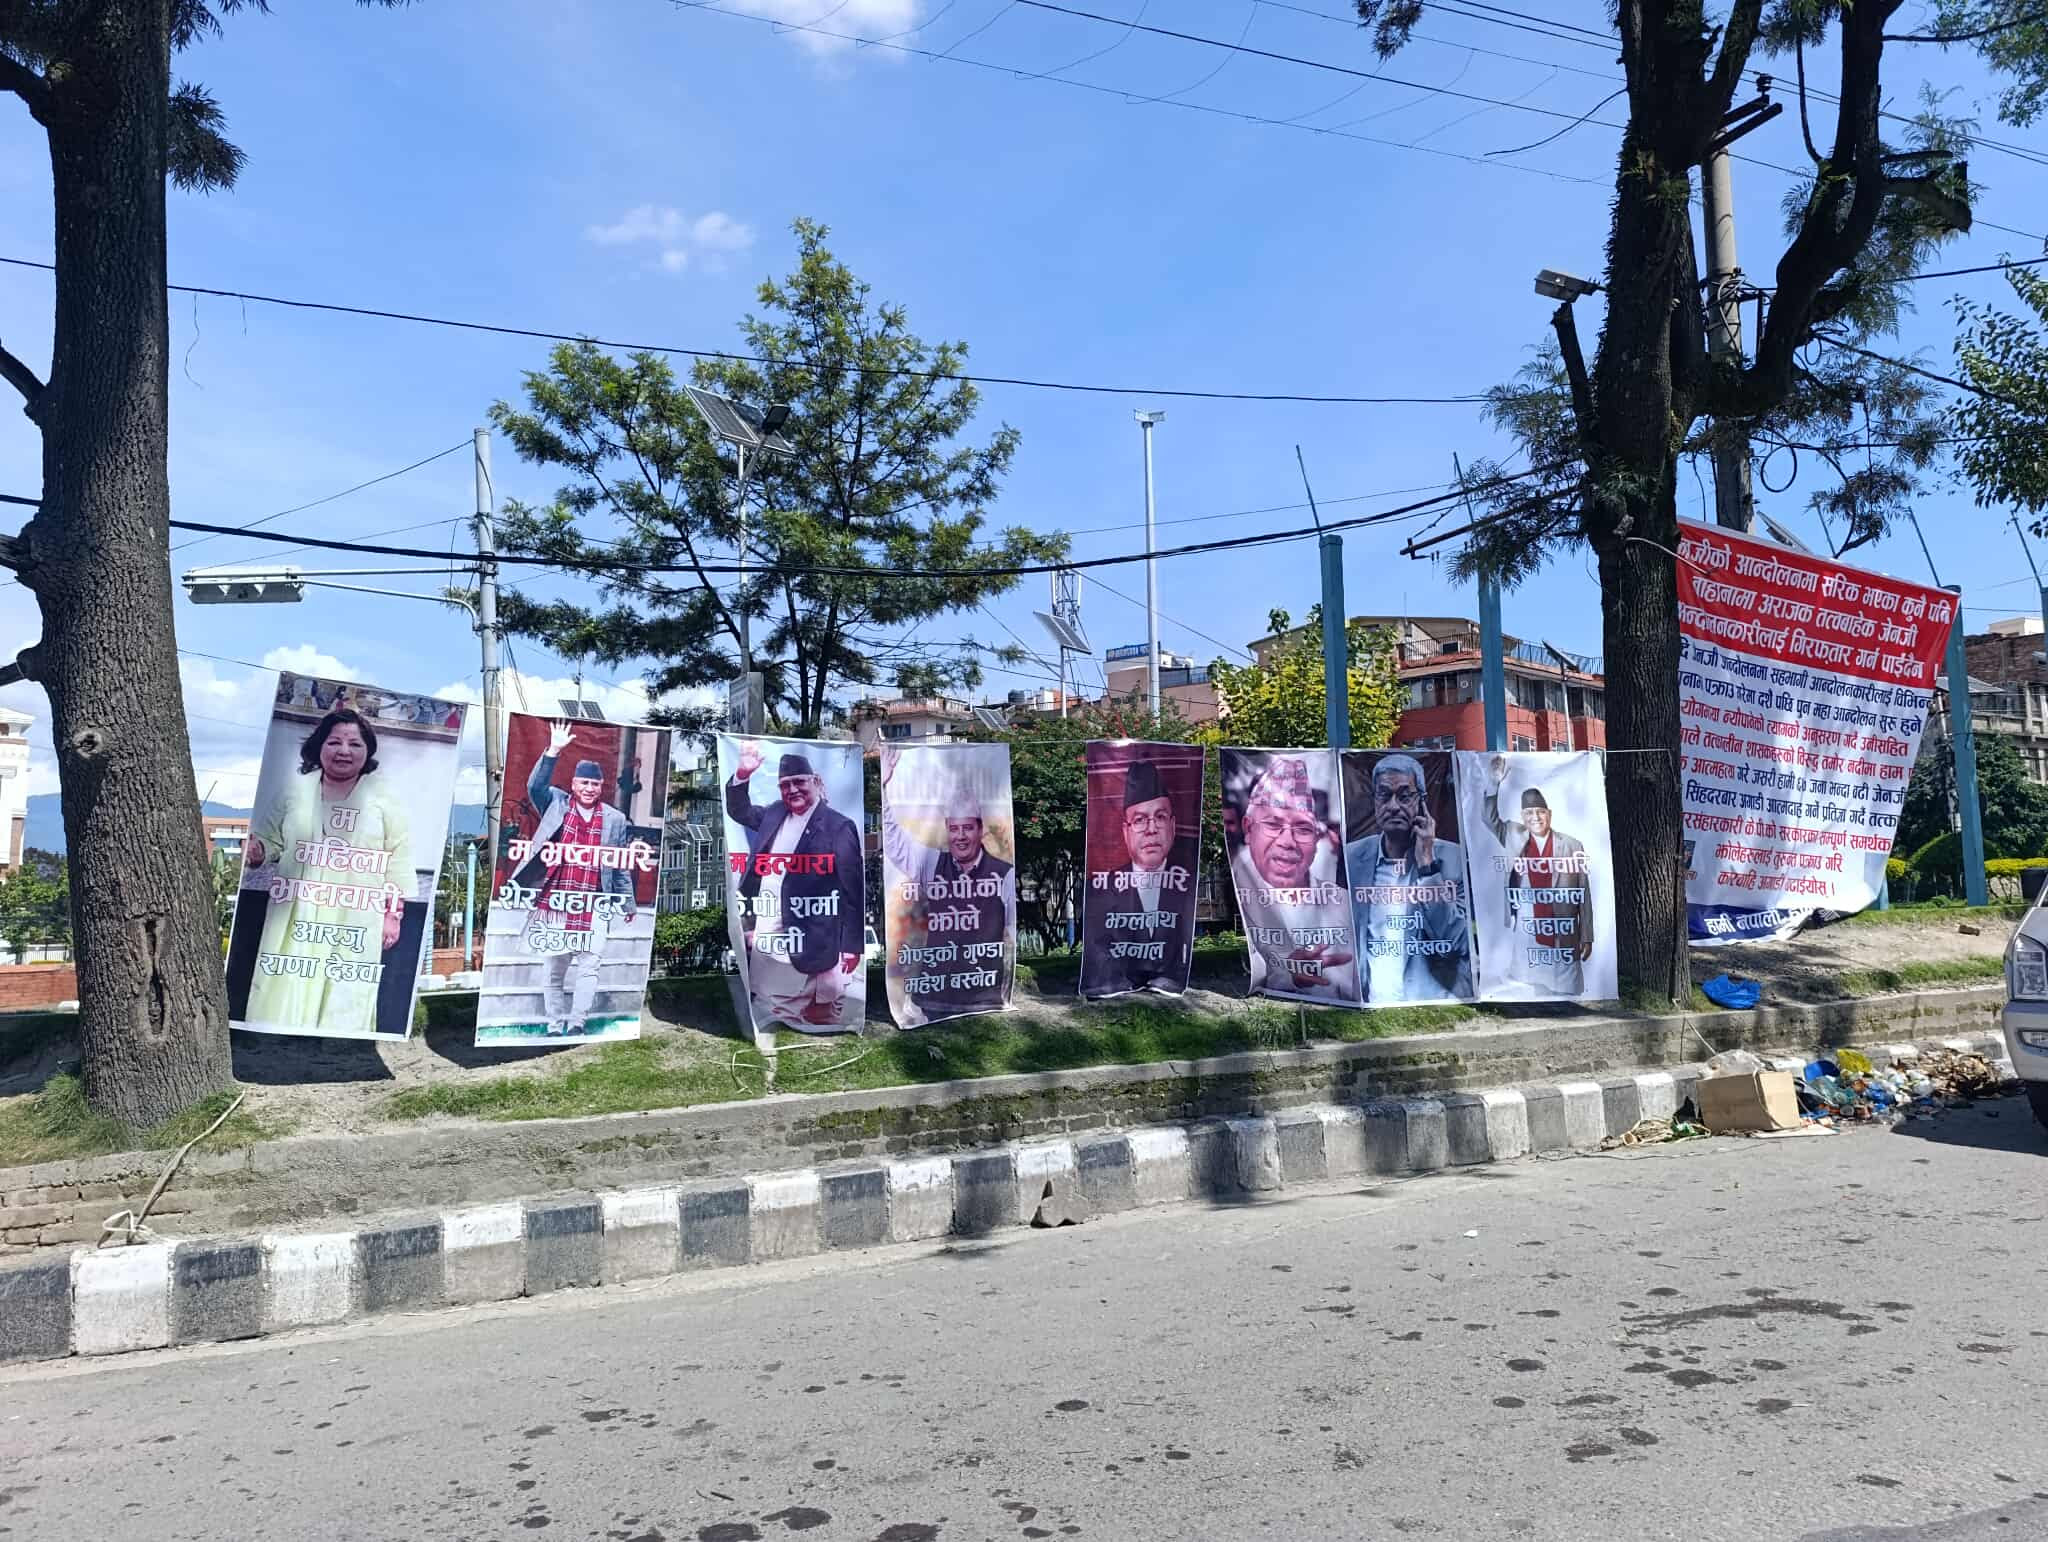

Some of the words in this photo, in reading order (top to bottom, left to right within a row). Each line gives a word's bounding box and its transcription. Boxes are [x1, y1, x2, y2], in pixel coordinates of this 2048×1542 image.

[1734, 553, 1819, 592] आन्दोलनमा
[1821, 573, 1862, 601] सरिक
[1862, 585, 1901, 613] भएका
[1901, 592, 1928, 622] कुनै
[1758, 593, 1816, 622] अराजक
[1878, 617, 1920, 648] जेनजी
[1769, 667, 1810, 689] सहभागी
[1832, 704, 1878, 727] आन्दोलन
[1899, 714, 1923, 737] हुने
[330, 806, 361, 832] म
[294, 836, 393, 875] महिला
[508, 839, 532, 862] म
[728, 852, 748, 875] म
[754, 852, 836, 876] हत्यारा
[1391, 858, 1407, 875] म
[901, 882, 921, 901] म
[926, 872, 1004, 901] के.पी.को
[1092, 871, 1110, 890] म
[498, 880, 542, 911] शेर
[548, 889, 633, 922] बहादुर
[789, 889, 840, 918] शर्मा
[927, 904, 981, 932] झोले
[1520, 917, 1576, 937] दाहाल
[1703, 912, 1736, 936] हामी
[528, 920, 596, 953] देउवा
[756, 925, 806, 955] वली
[1291, 927, 1349, 951] कुमार
[1404, 936, 1454, 957] लेखक
[897, 940, 959, 968] गेण्डुको
[961, 941, 1005, 964] गुण्डा
[1109, 941, 1167, 961] खनाल
[259, 953, 321, 979] राणा
[324, 953, 386, 984] देउवा
[903, 971, 947, 994] महेश
